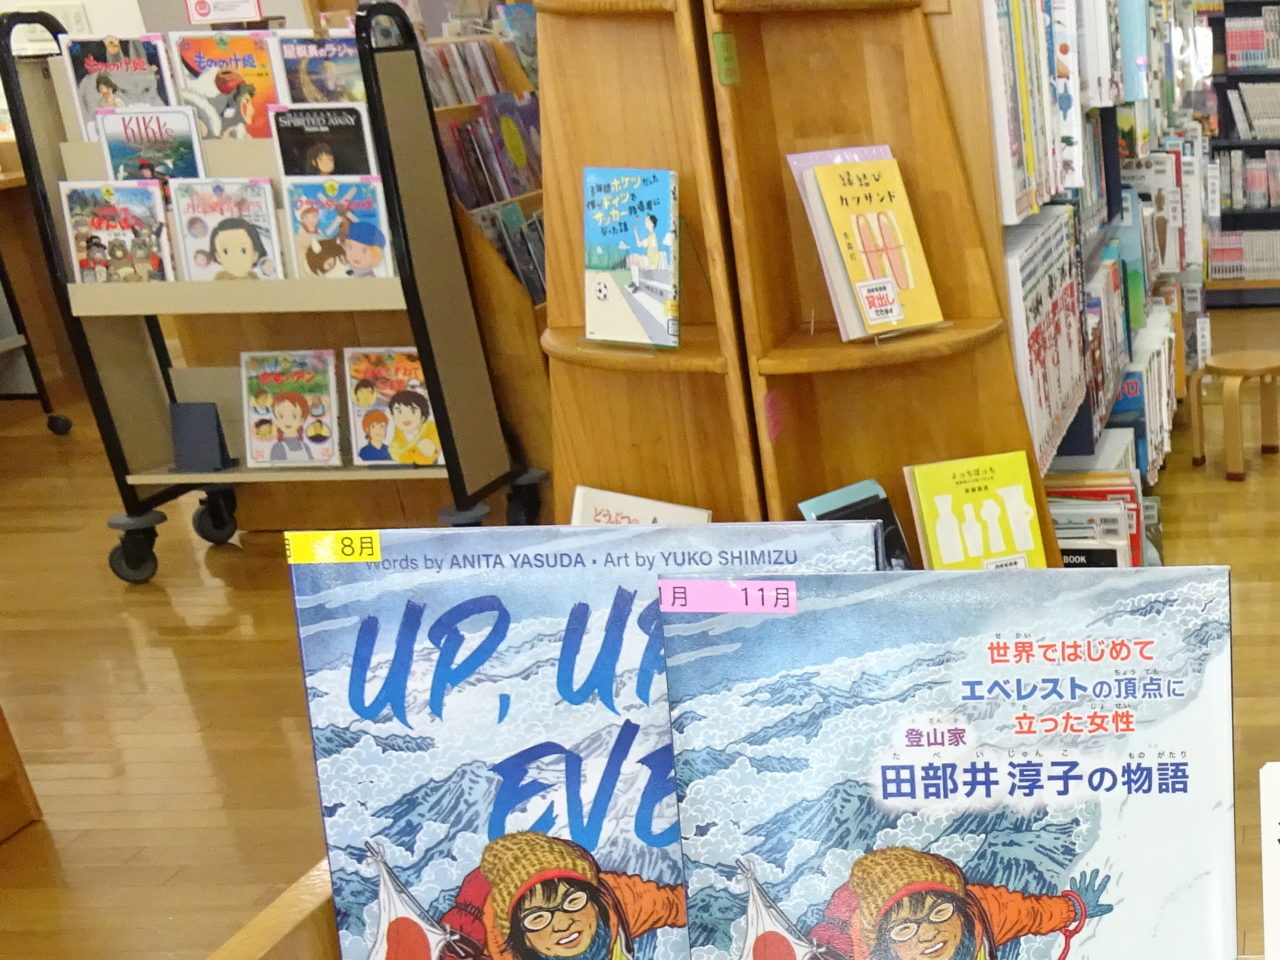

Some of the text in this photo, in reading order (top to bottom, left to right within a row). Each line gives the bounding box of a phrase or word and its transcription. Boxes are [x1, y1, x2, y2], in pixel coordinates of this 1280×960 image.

[193, 53, 257, 69] もののけ姫
[340, 536, 375, 557] 8月
[424, 553, 444, 573] by
[450, 553, 503, 570] ANITA
[508, 552, 587, 569] YASUDA
[603, 552, 630, 568] Art
[635, 550, 656, 571] by
[660, 550, 713, 567] YUKO
[718, 549, 798, 566] SHIMIZU
[1062, 555, 1088, 565] BOOK
[987, 639, 1156, 664] 世界ではじめて
[961, 676, 1186, 701] エベレストの頂点に
[1014, 709, 1136, 735] 立った女性
[904, 726, 968, 748] 登山家
[880, 760, 1190, 800] 田部井淳子の物語
